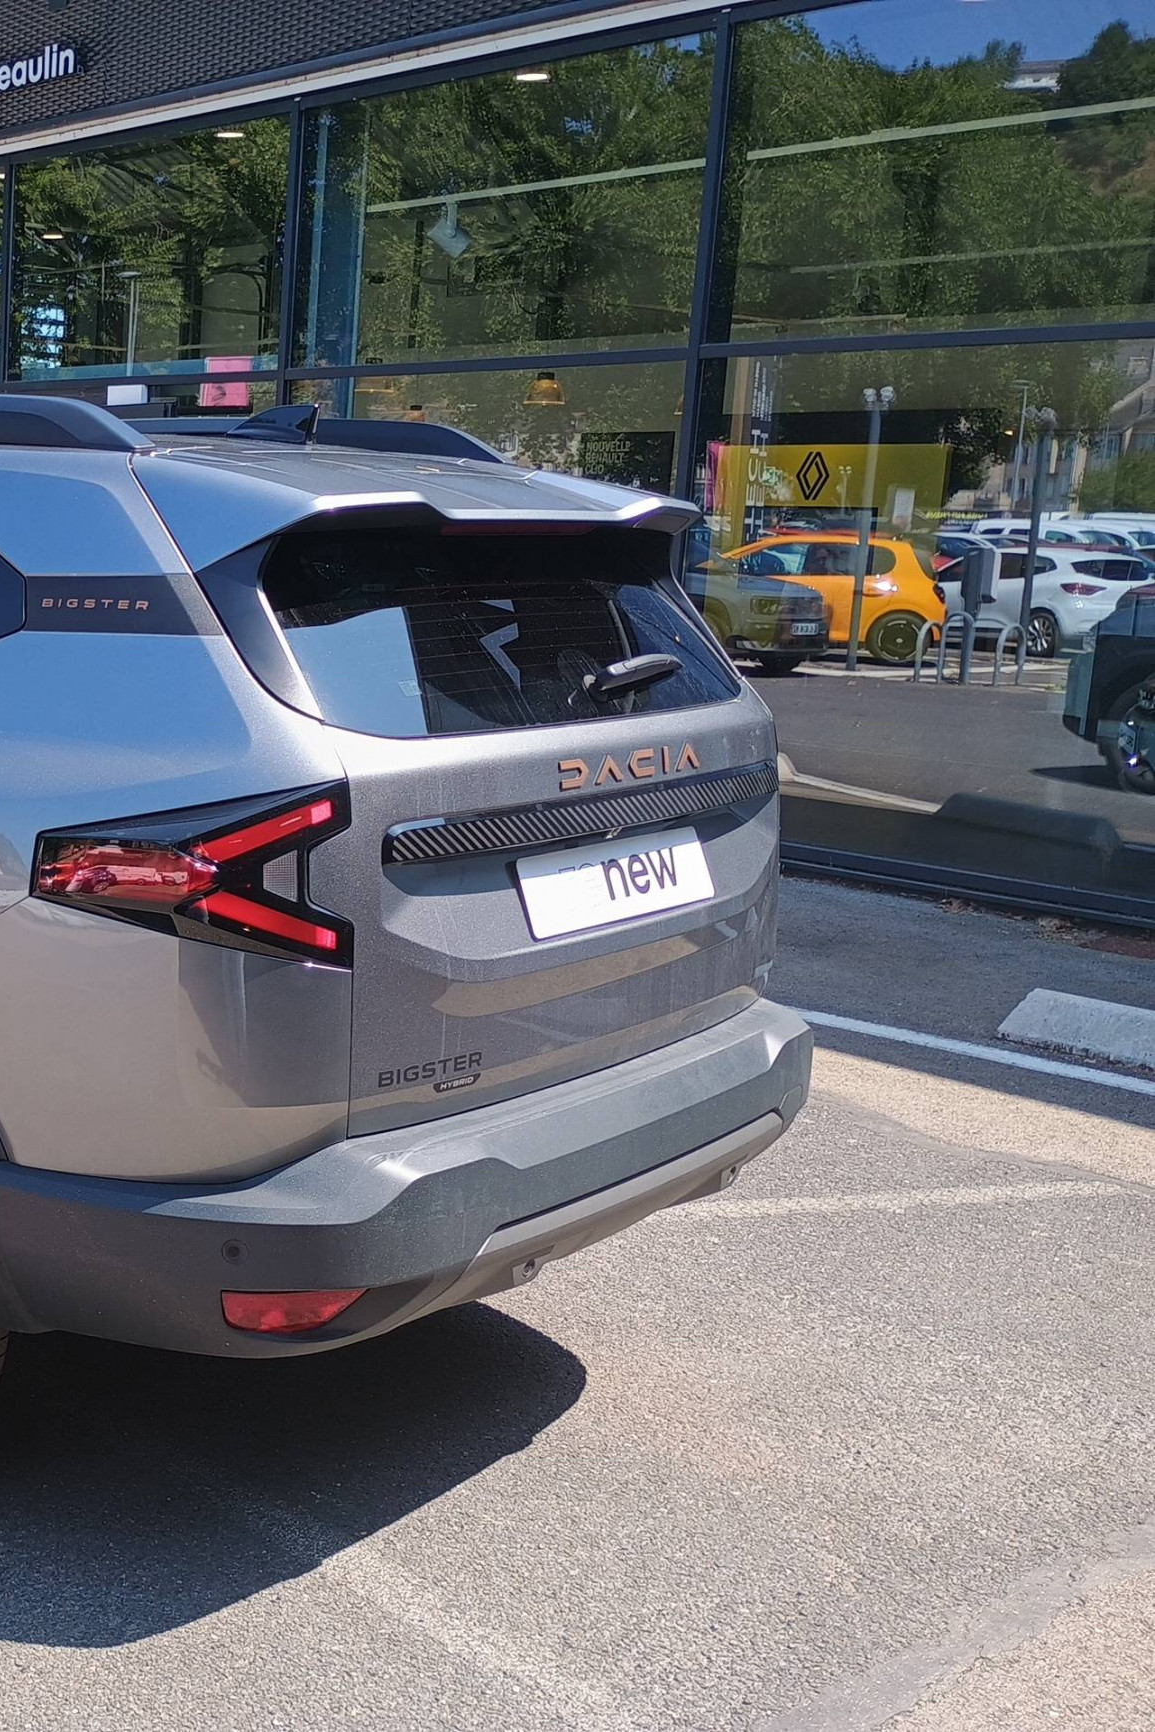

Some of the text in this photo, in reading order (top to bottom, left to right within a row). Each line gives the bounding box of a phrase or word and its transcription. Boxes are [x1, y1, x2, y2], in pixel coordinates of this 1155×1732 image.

[584, 463, 605, 475] CLIO
[41, 598, 149, 610] BIGSTER
[557, 742, 700, 792] DACIA
[378, 1051, 483, 1088] BIGSTER
[439, 1076, 474, 1091] HYBRID
